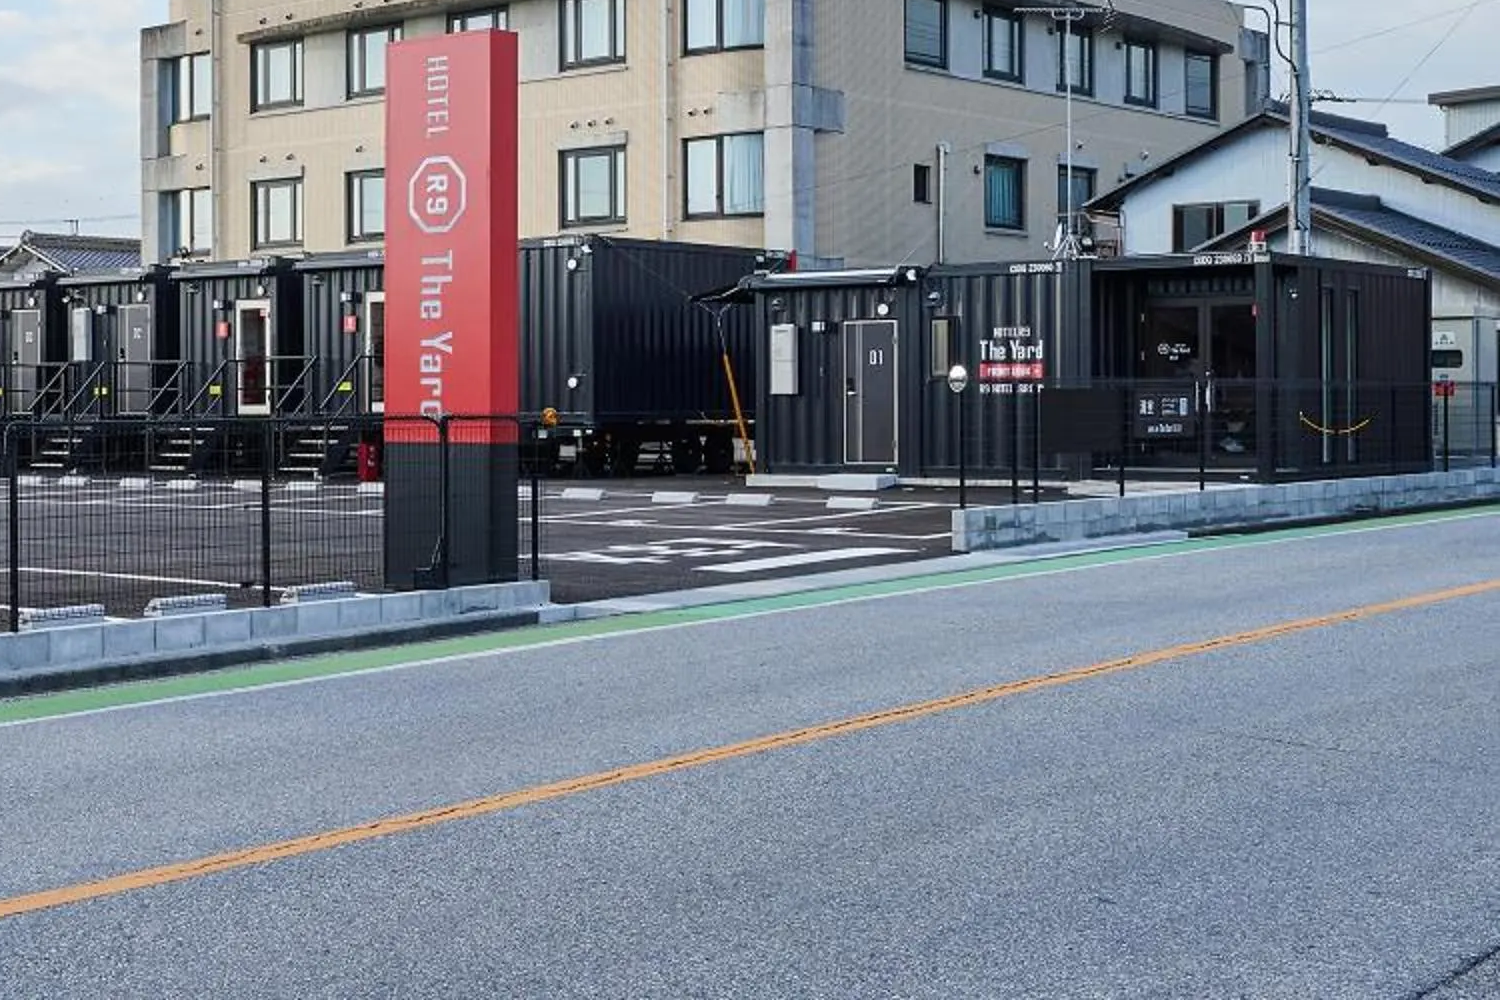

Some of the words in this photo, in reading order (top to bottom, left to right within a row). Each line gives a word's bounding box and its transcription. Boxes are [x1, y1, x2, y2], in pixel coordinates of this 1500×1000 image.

[426, 55, 449, 139] HOTEL
[426, 173, 448, 215] R9
[419, 248, 453, 320] The
[870, 349, 883, 365] 01
[980, 340, 1006, 361] The
[1009, 340, 1044, 360] Yard
